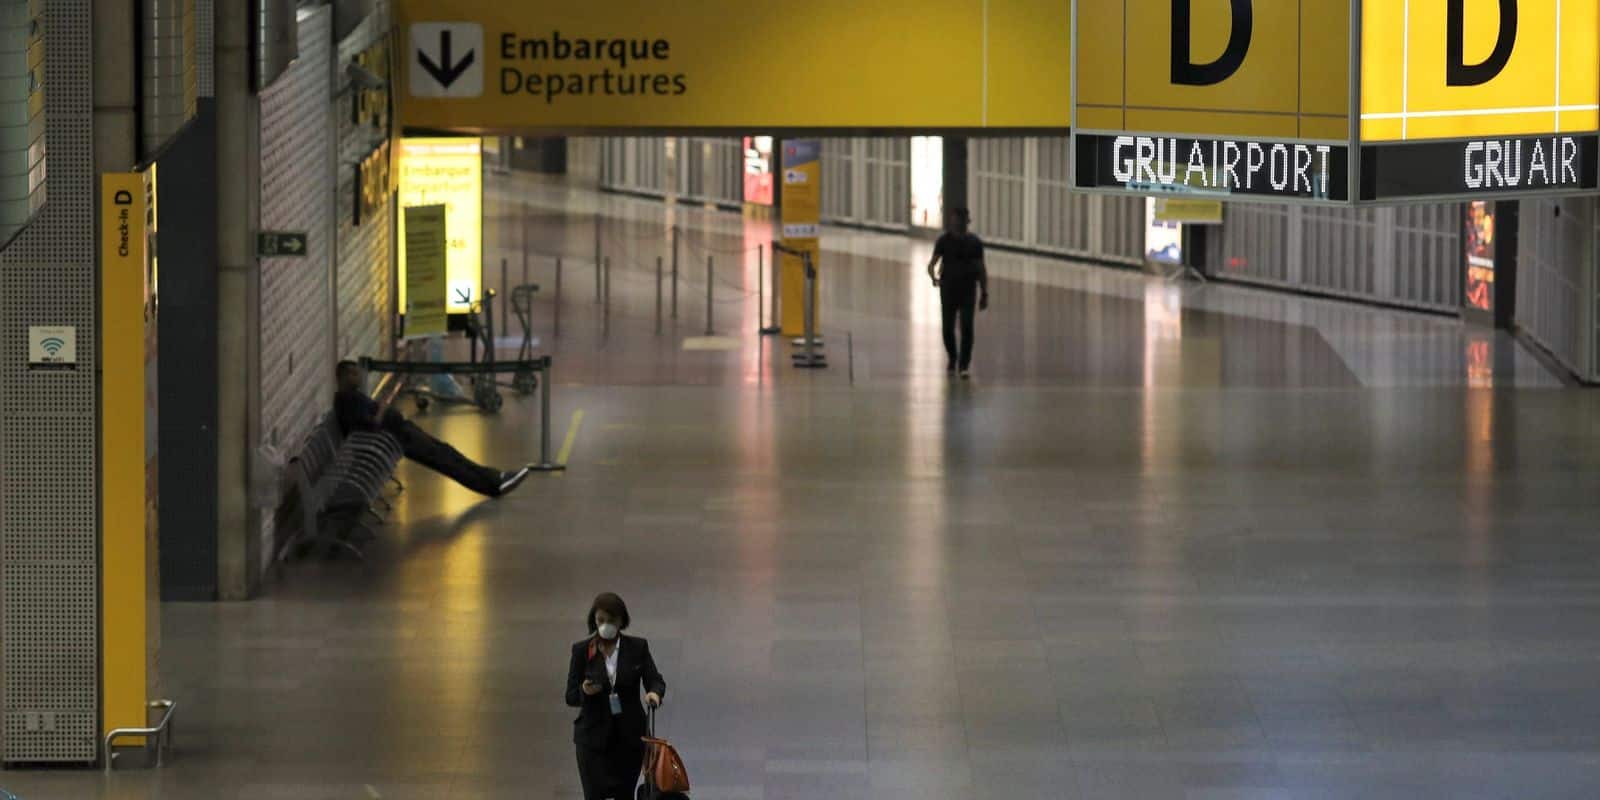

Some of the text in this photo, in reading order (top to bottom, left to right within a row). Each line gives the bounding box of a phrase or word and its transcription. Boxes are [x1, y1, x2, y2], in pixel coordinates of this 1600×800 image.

[500, 31, 670, 67] Embarque
[1171, 0, 1253, 86] D
[1446, 0, 1519, 87] D
[500, 67, 687, 103] Departures
[1113, 136, 1331, 193] GRU AIRPORT
[1464, 137, 1577, 188] GRU AIR
[114, 190, 132, 257] Check-in D
